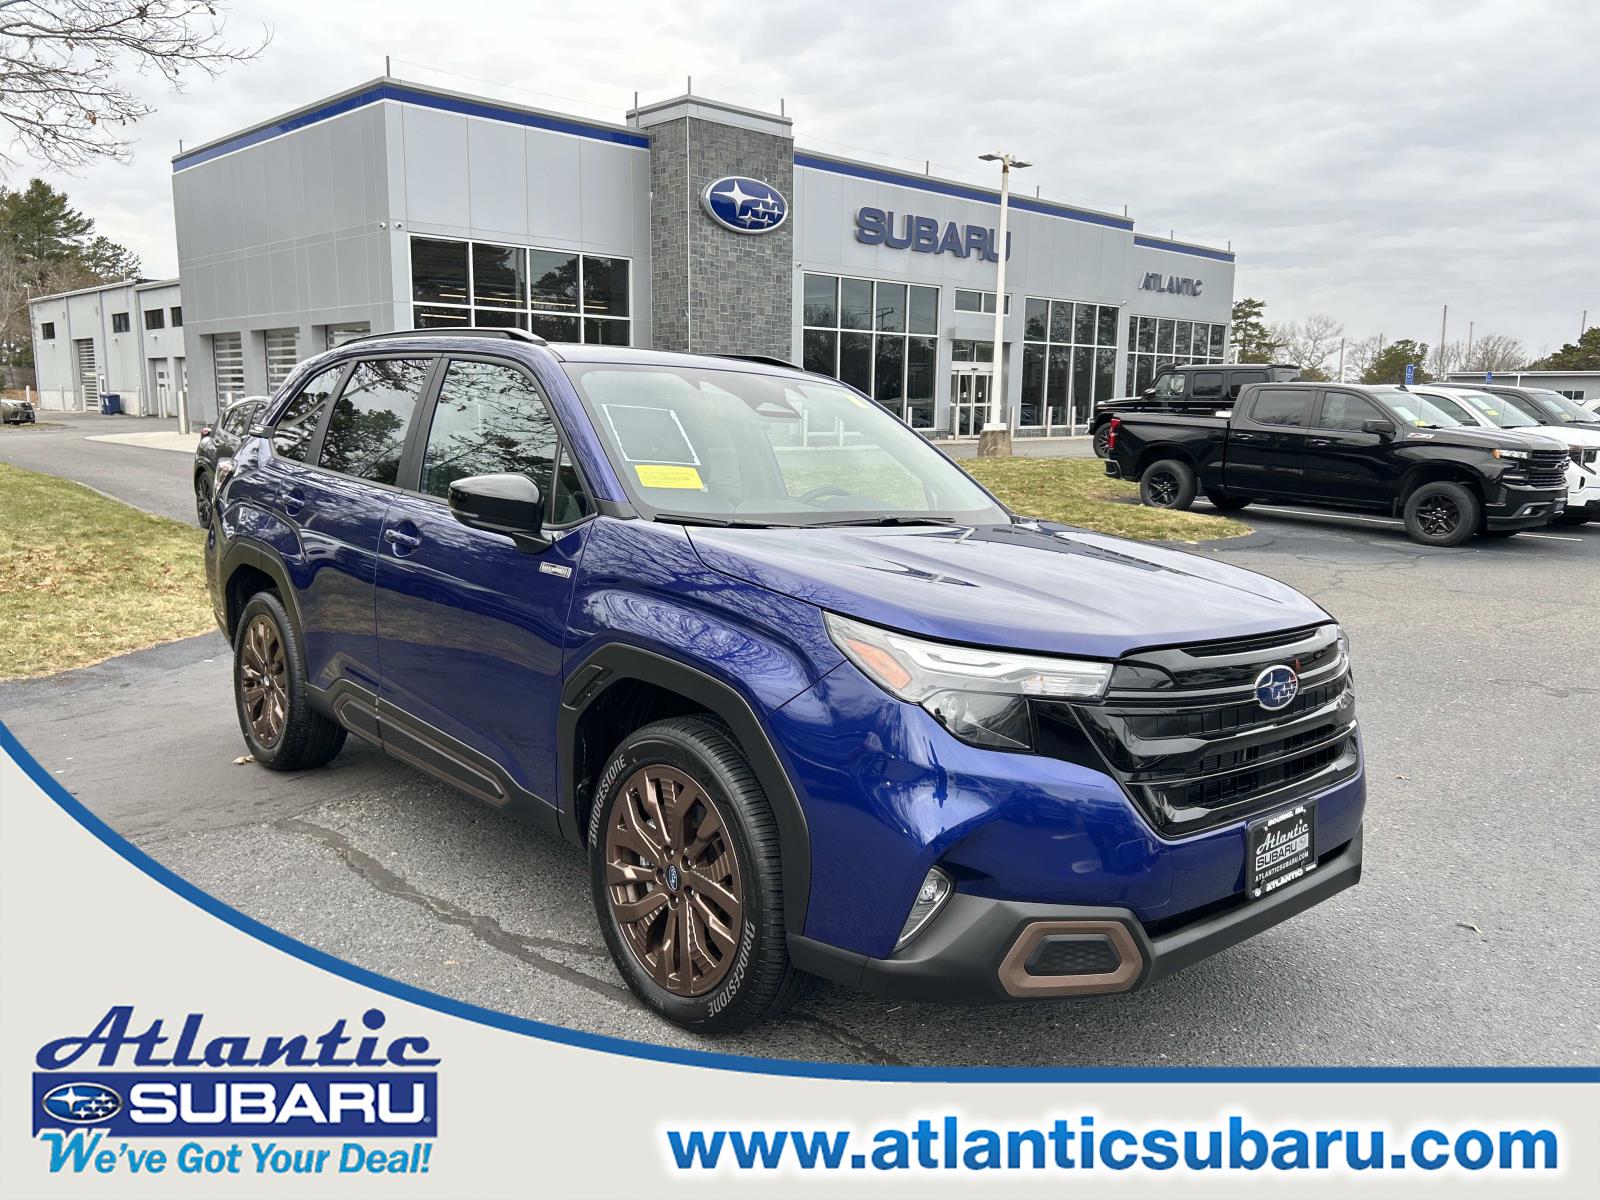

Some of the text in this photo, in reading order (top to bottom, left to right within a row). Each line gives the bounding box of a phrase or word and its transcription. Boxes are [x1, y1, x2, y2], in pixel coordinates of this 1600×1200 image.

[856, 206, 1012, 262] SUBARU
[1139, 272, 1202, 296] ATLANTIC
[588, 753, 627, 848] BRIDGESTONE
[1256, 819, 1309, 855] Atlantic
[1257, 840, 1298, 870] SUBARU
[1255, 851, 1309, 881] ATLANTICSUBARU.COM
[707, 917, 757, 1018] BRIDGESTONE
